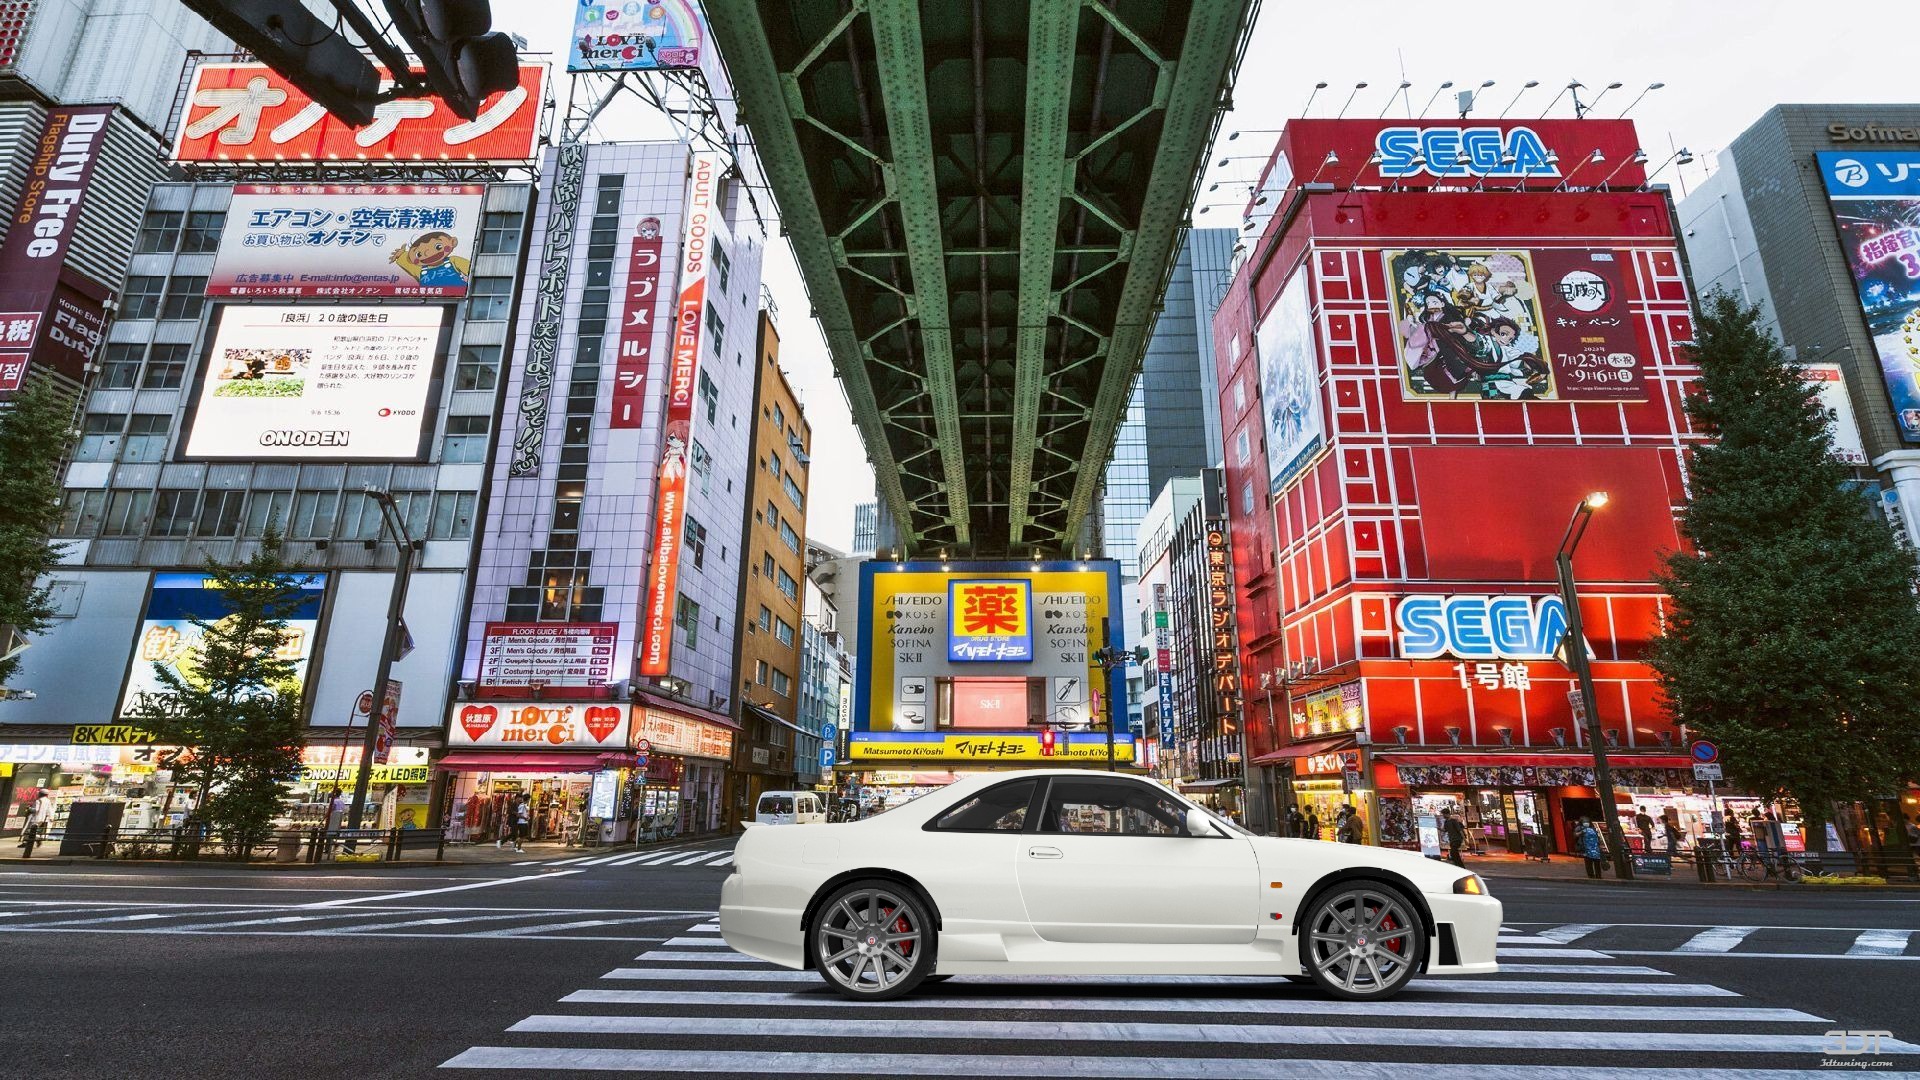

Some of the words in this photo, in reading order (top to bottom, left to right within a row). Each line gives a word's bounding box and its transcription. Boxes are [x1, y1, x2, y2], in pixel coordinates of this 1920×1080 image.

[595, 34, 645, 47] LOVE
[34, 114, 68, 176] Flagship
[49, 114, 107, 182] Duty
[1375, 126, 1562, 178] SEGA
[693, 160, 711, 209] ADULT
[19, 180, 45, 224] Store
[27, 188, 82, 258] Free
[248, 208, 456, 230] エアコン・空気清浄機
[686, 214, 708, 273] GOODS
[59, 298, 84, 316] Home
[54, 309, 104, 346] Flag
[680, 300, 698, 346] LOVE
[49, 326, 97, 359] Duty
[619, 249, 657, 421] ラブメルシー
[673, 351, 694, 406] MERCI
[259, 430, 350, 447] ONODEN
[649, 491, 676, 666] www.akibalovemerci.com
[880, 595, 942, 606] SHISEIDO
[964, 586, 1019, 633] 薬
[1038, 595, 1101, 606] SHISEIDO
[905, 610, 936, 619] KOSÉ
[887, 624, 934, 635] Kanebo
[1046, 624, 1094, 635] Kanebo
[1394, 595, 1597, 660] SEGA
[890, 638, 932, 648] SOFINA
[953, 643, 1027, 660] マツモトキヨシ
[1050, 638, 1093, 648] SOFINA
[1210, 551, 1236, 735] 東京ラジオデパート
[898, 653, 923, 663] SK-II
[503, 668, 533, 676] Costume
[1453, 662, 1532, 691] 1号館
[465, 713, 492, 723] 秋葉原
[510, 706, 570, 727] LOVE
[75, 726, 101, 743] 8K
[103, 726, 128, 743] 4K
[823, 751, 833, 764] P
[863, 747, 911, 756] Matsumoto
[955, 741, 1026, 757] マツモトキヨシ
[303, 769, 351, 781] ONODEN
